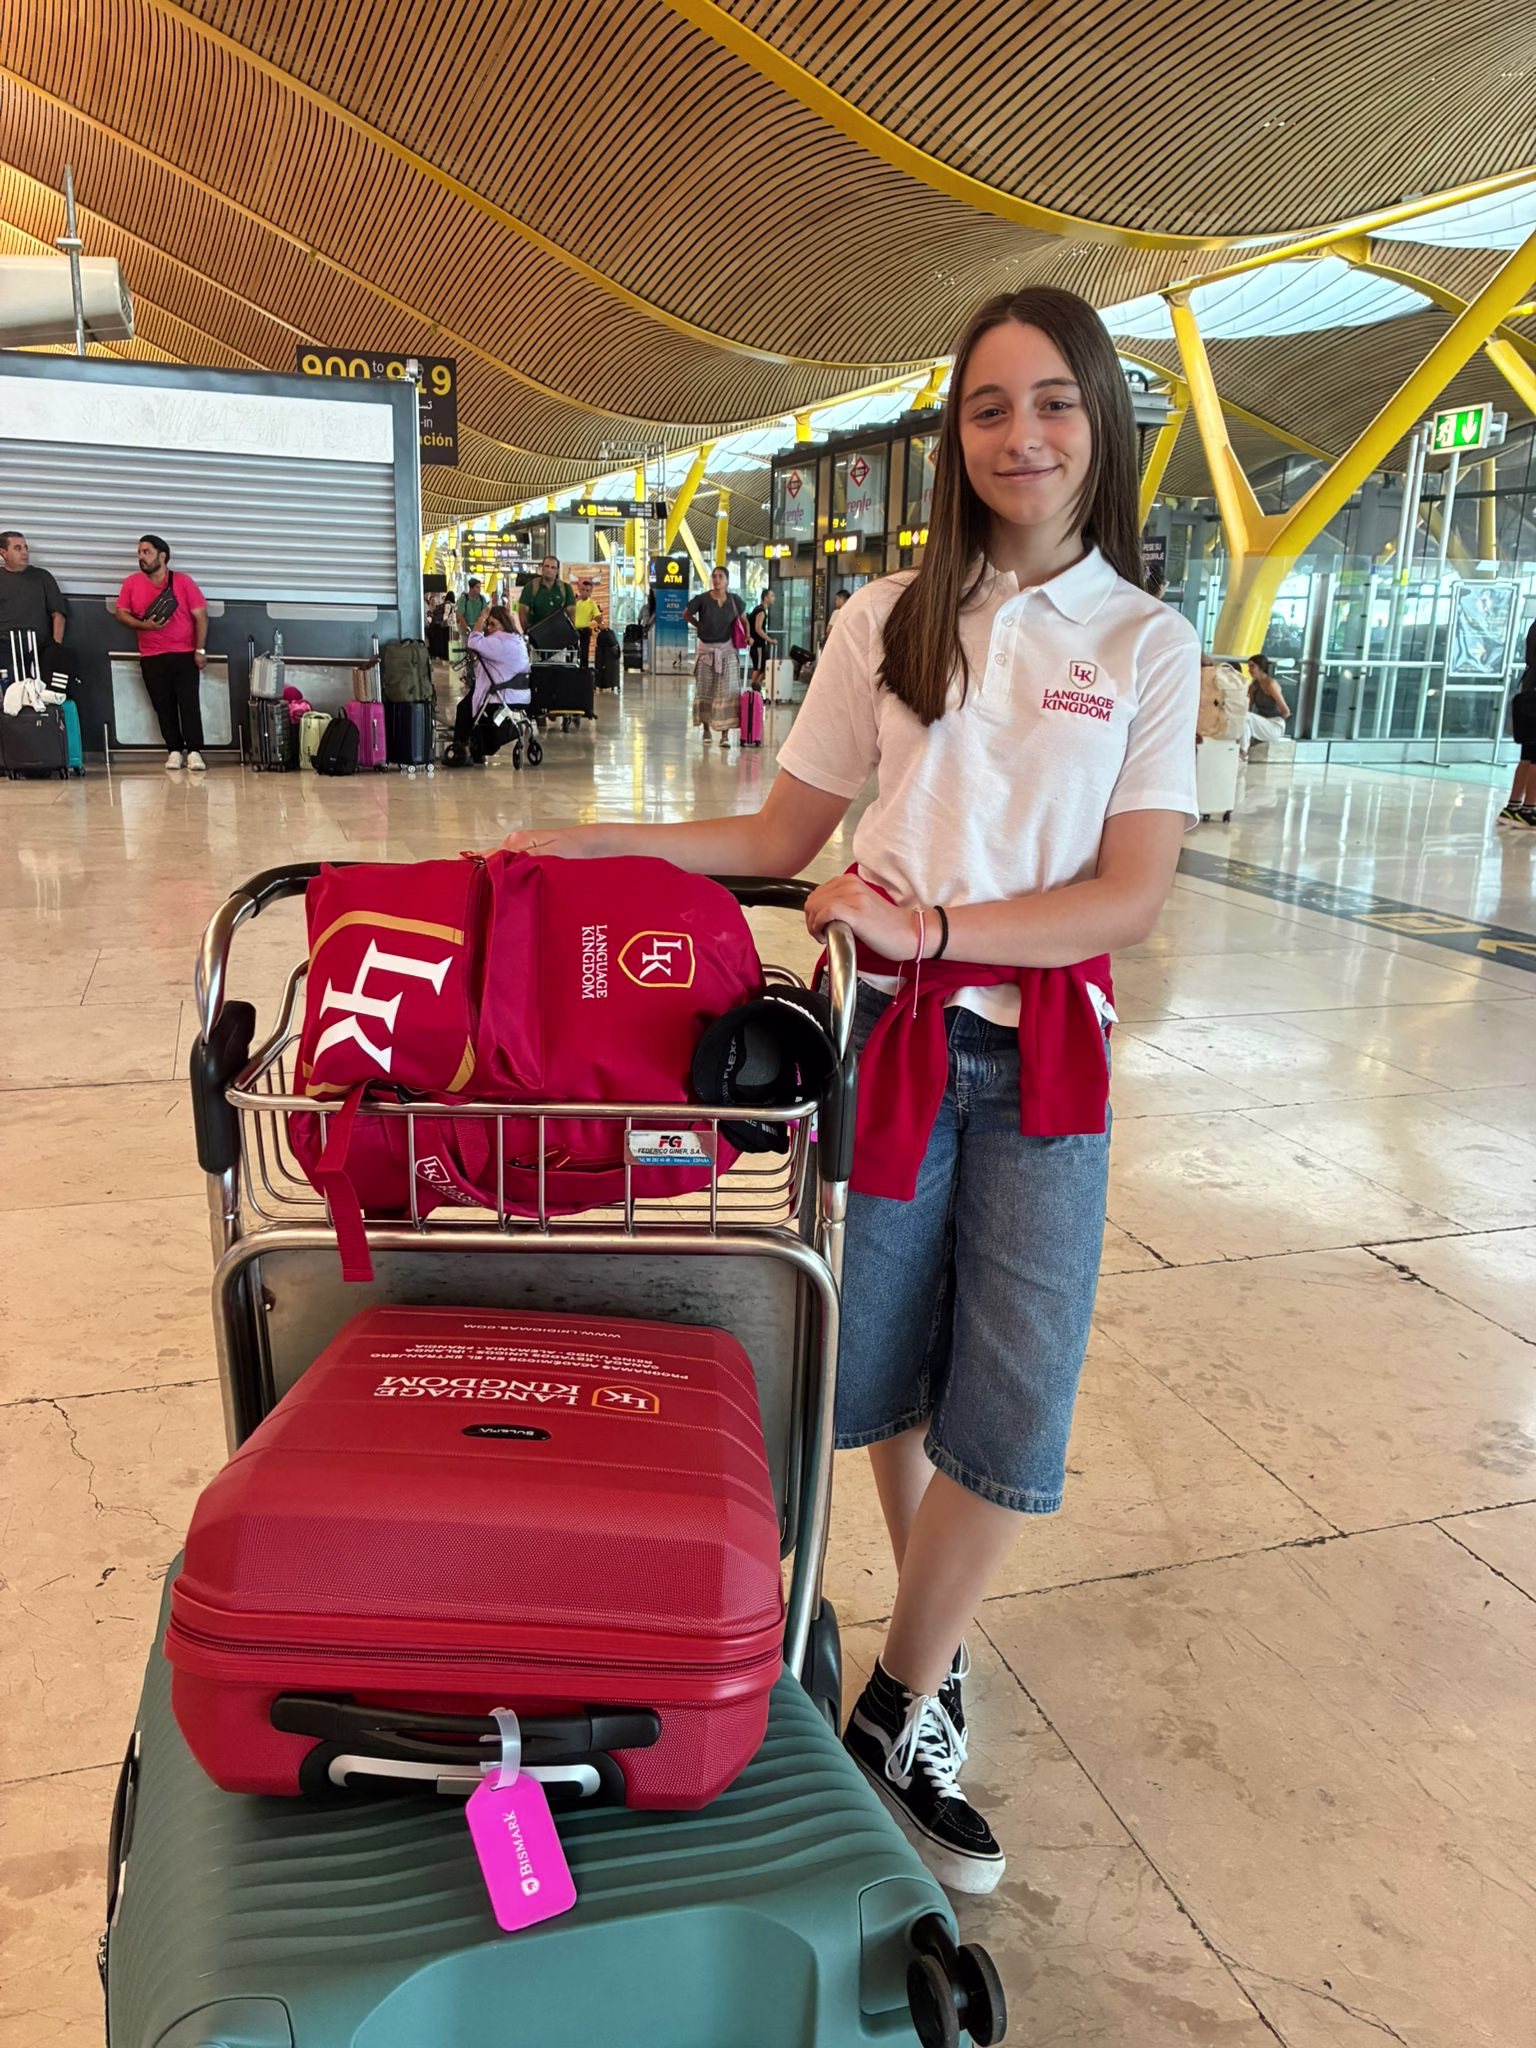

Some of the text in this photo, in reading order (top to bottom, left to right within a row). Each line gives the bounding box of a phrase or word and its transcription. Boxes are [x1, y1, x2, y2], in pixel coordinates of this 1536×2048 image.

[372, 360, 385, 373] to
[386, 361, 451, 396] 99
[846, 491, 872, 518] renfe
[664, 574, 683, 583] ATM
[1073, 665, 1093, 683] LK
[1043, 689, 1115, 710] LANGUAGE
[1041, 698, 1111, 722] KINGDOM
[581, 925, 595, 1000] KINGDOM
[595, 924, 608, 999] LANGUAGE
[639, 937, 682, 980] LK
[313, 938, 454, 1074] LK
[658, 1135, 683, 1148] FG
[464, 1324, 621, 1338] WWW.LKIDIOMAS.COM
[485, 1346, 557, 1354] ALEMANIA
[532, 1353, 593, 1362] ESTADOS
[566, 1352, 609, 1360] UNIDO
[508, 1357, 599, 1368] ACADÉMICOS
[612, 1356, 653, 1365] REINO
[602, 1364, 689, 1380] PROGRAMAS
[379, 1376, 582, 1396] KINGDOM
[373, 1387, 579, 1405] LANGUAGE
[603, 1389, 649, 1410] LK
